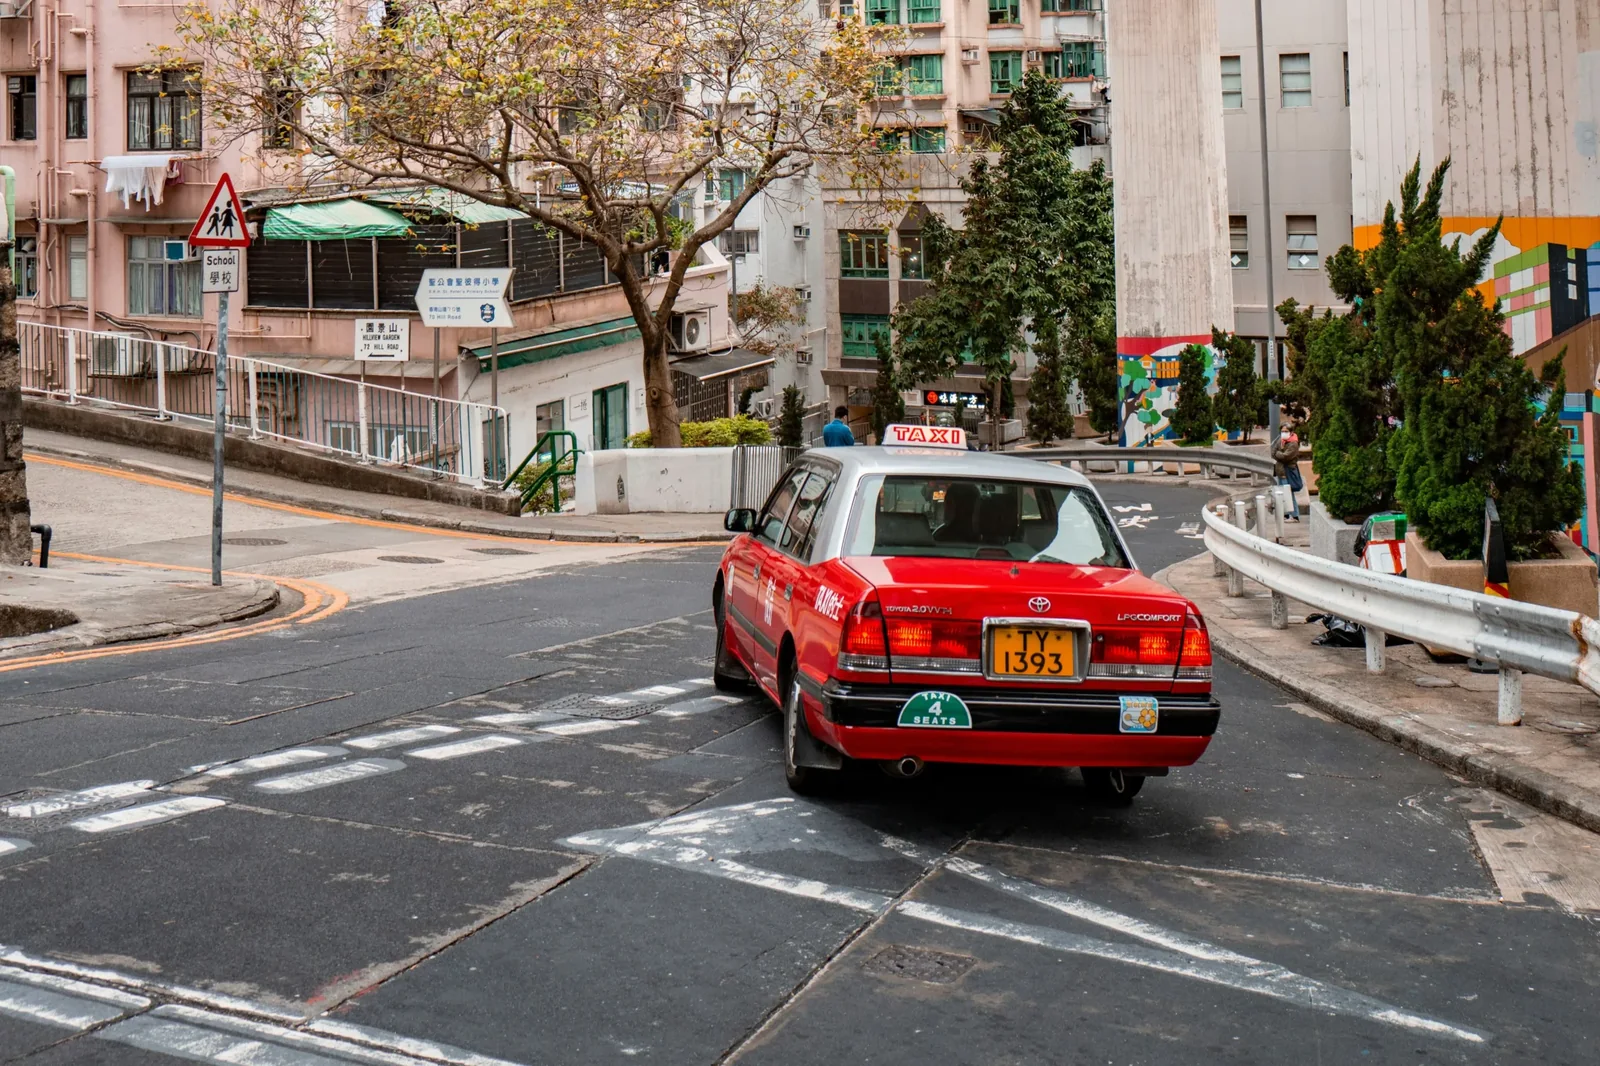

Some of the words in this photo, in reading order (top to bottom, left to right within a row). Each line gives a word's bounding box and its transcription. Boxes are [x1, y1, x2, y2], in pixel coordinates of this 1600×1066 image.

[206, 255, 236, 266] School
[209, 271, 232, 286] 學校
[893, 426, 961, 444] TAXI
[885, 605, 912, 613] TOYOTA
[1017, 630, 1049, 652] TY
[1005, 651, 1063, 674] 1393
[921, 692, 951, 702] TAXI
[928, 700, 942, 716] 4
[913, 715, 956, 725] SEATS
